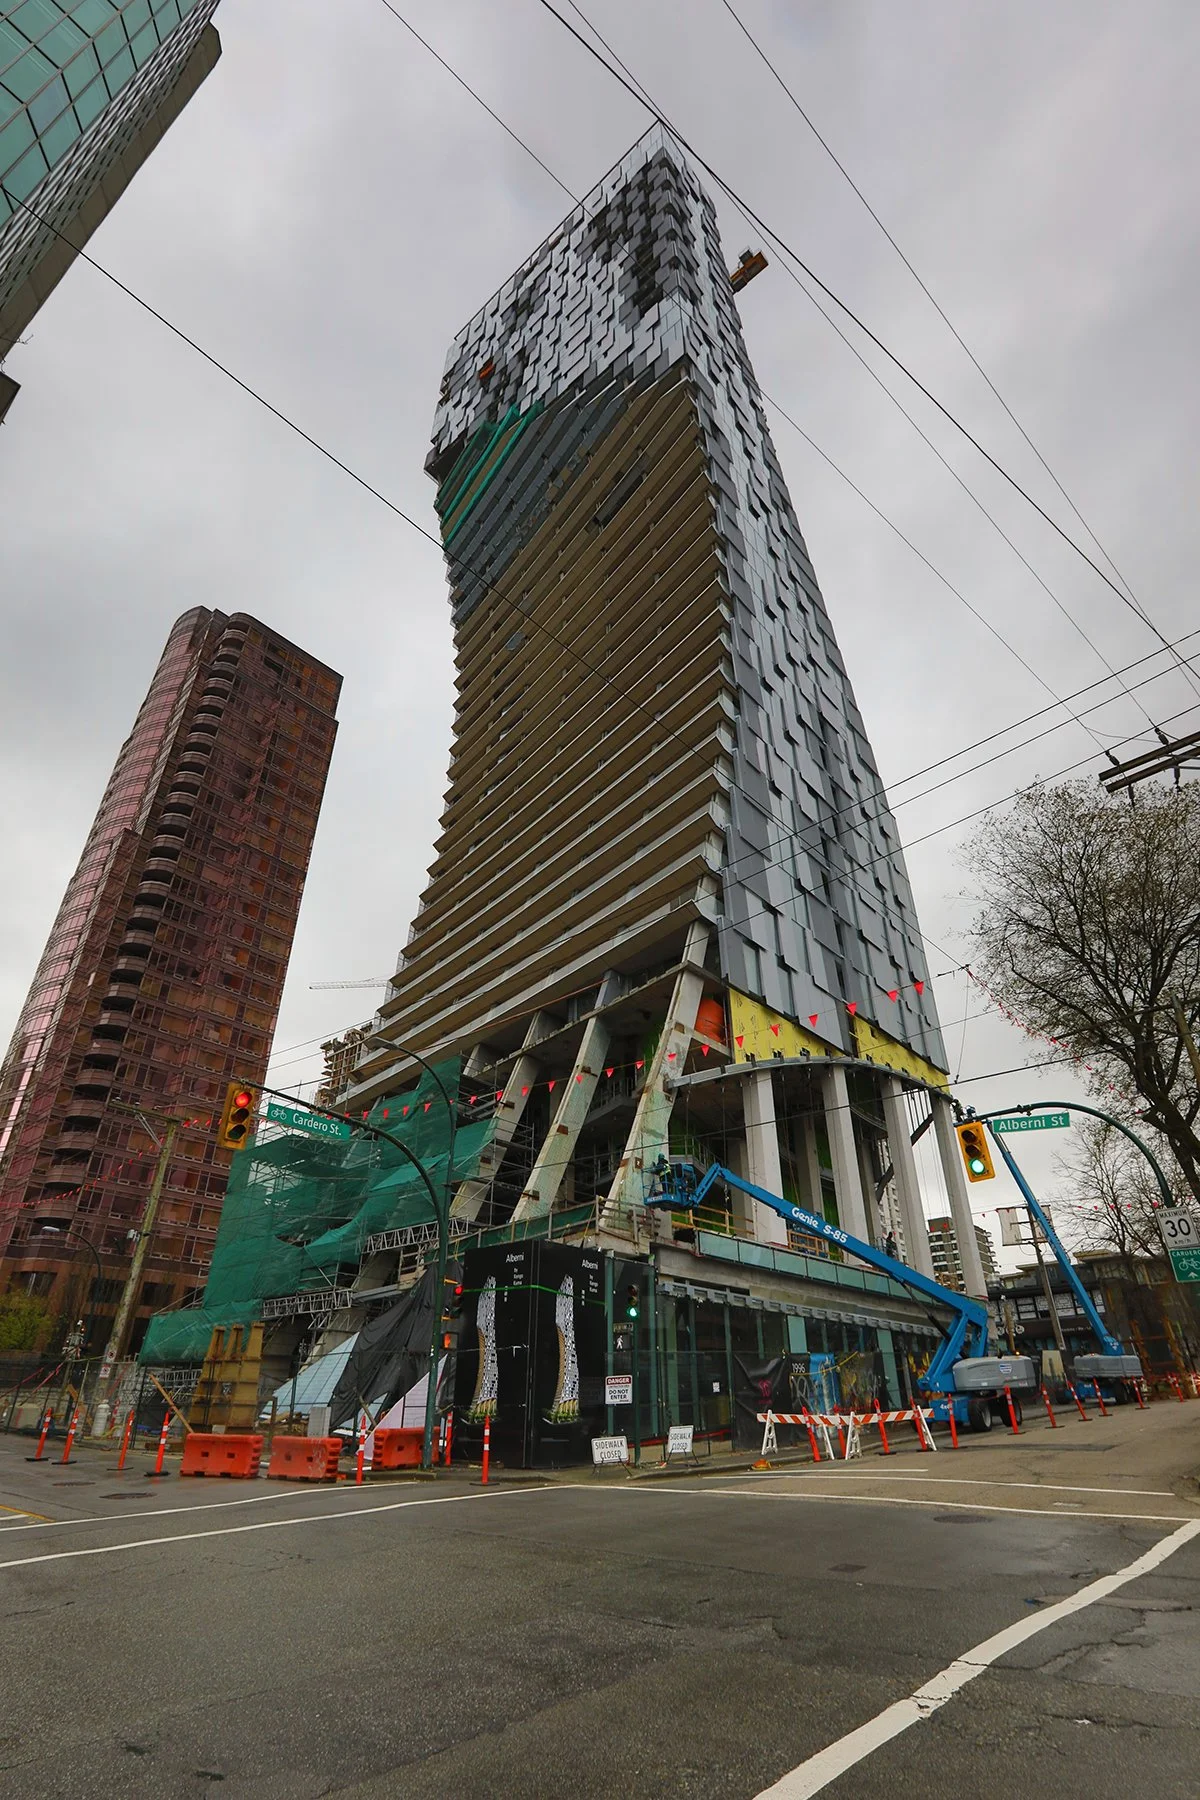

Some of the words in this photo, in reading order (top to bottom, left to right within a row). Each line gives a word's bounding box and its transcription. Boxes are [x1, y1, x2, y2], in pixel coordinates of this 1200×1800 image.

[292, 1113, 328, 1132] Cardero
[329, 1123, 342, 1136] St.
[999, 1117, 1046, 1131] Alberni
[1051, 1116, 1064, 1127] St
[1159, 1210, 1187, 1218] MAXIMUM
[791, 1207, 819, 1228] Genie
[823, 1225, 848, 1243] S-85
[1165, 1218, 1191, 1237] 30
[505, 1252, 524, 1263] Alberni
[581, 1259, 599, 1270] Alberni
[792, 1363, 806, 1373] 1996
[595, 1440, 624, 1449] SIDEWALK
[672, 1442, 688, 1450] CLOSED
[600, 1450, 622, 1459] CLOSED
